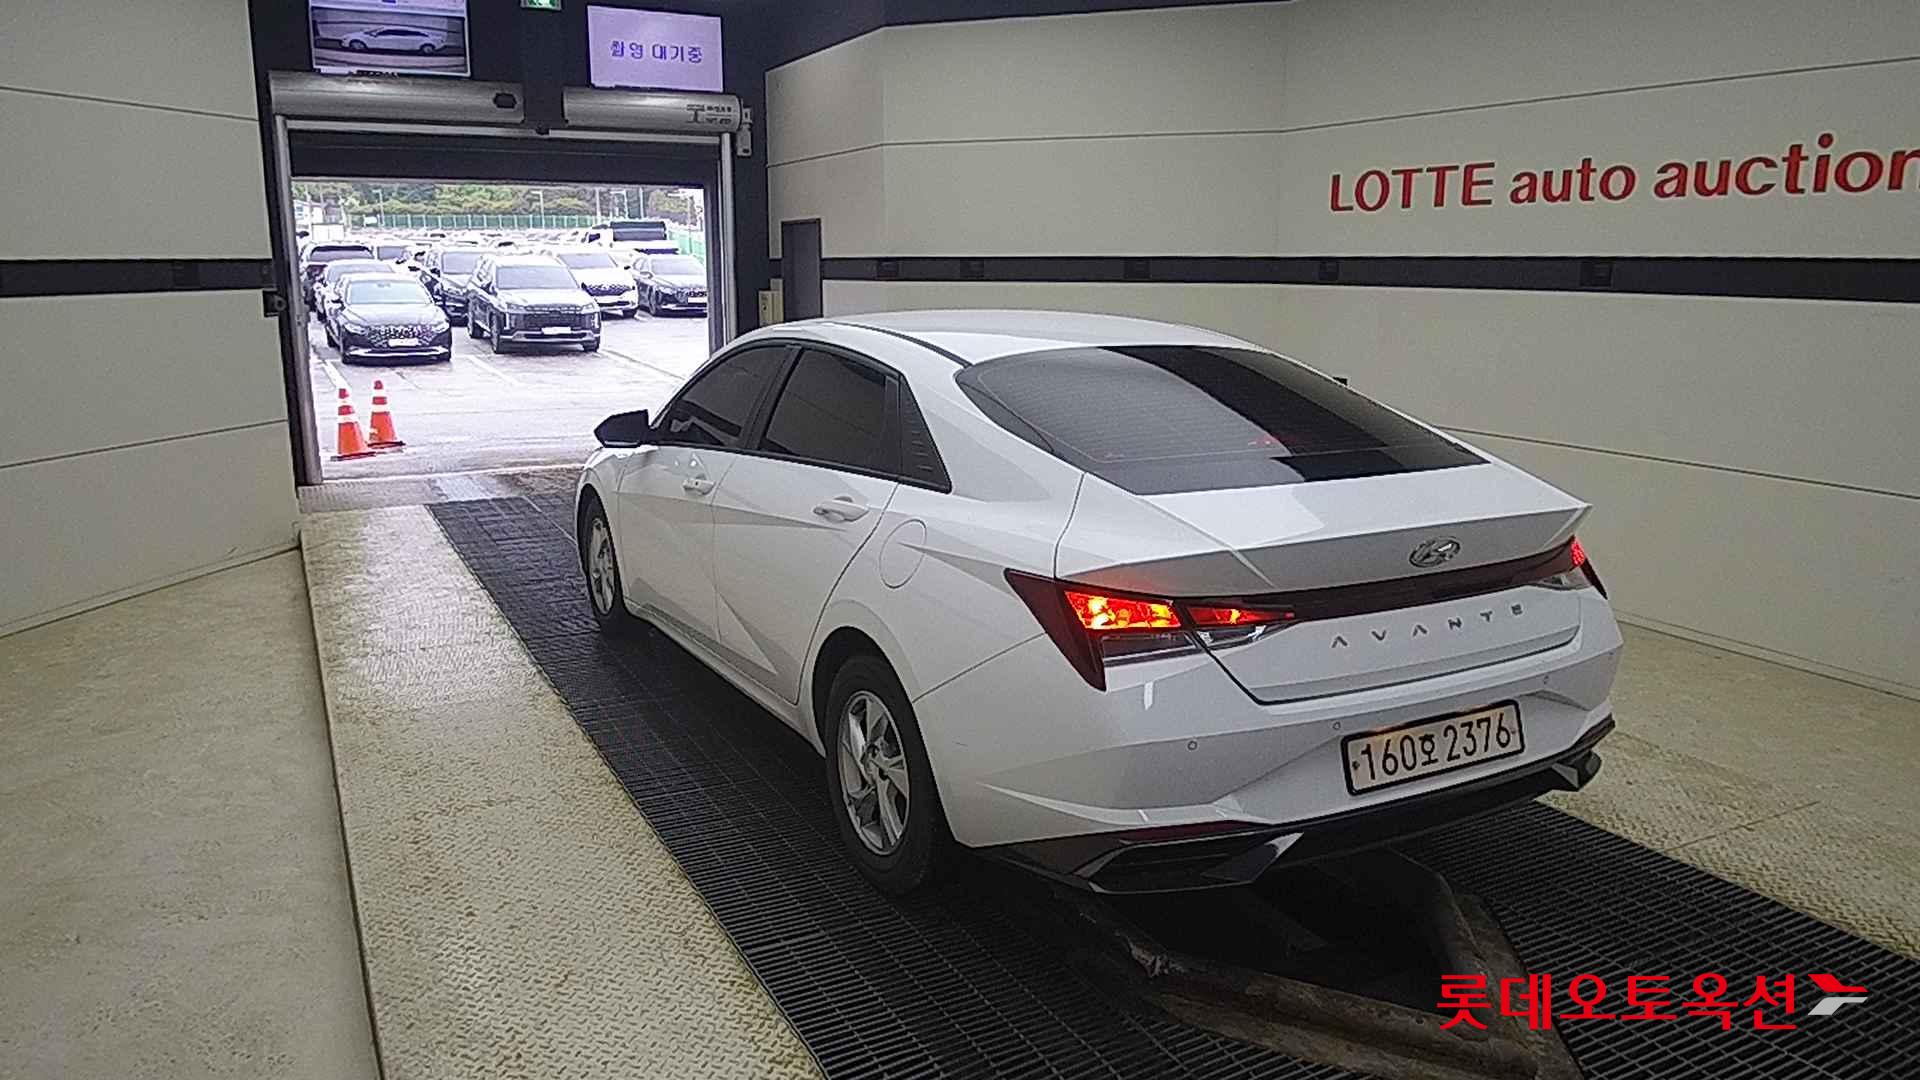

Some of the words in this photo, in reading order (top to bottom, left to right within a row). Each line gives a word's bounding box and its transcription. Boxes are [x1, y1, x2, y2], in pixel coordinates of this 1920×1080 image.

[652, 44, 702, 64] 대기중
[1330, 162, 1495, 212] LOTTE
[1510, 157, 1636, 204] auto
[1331, 603, 1524, 649] AVANTE
